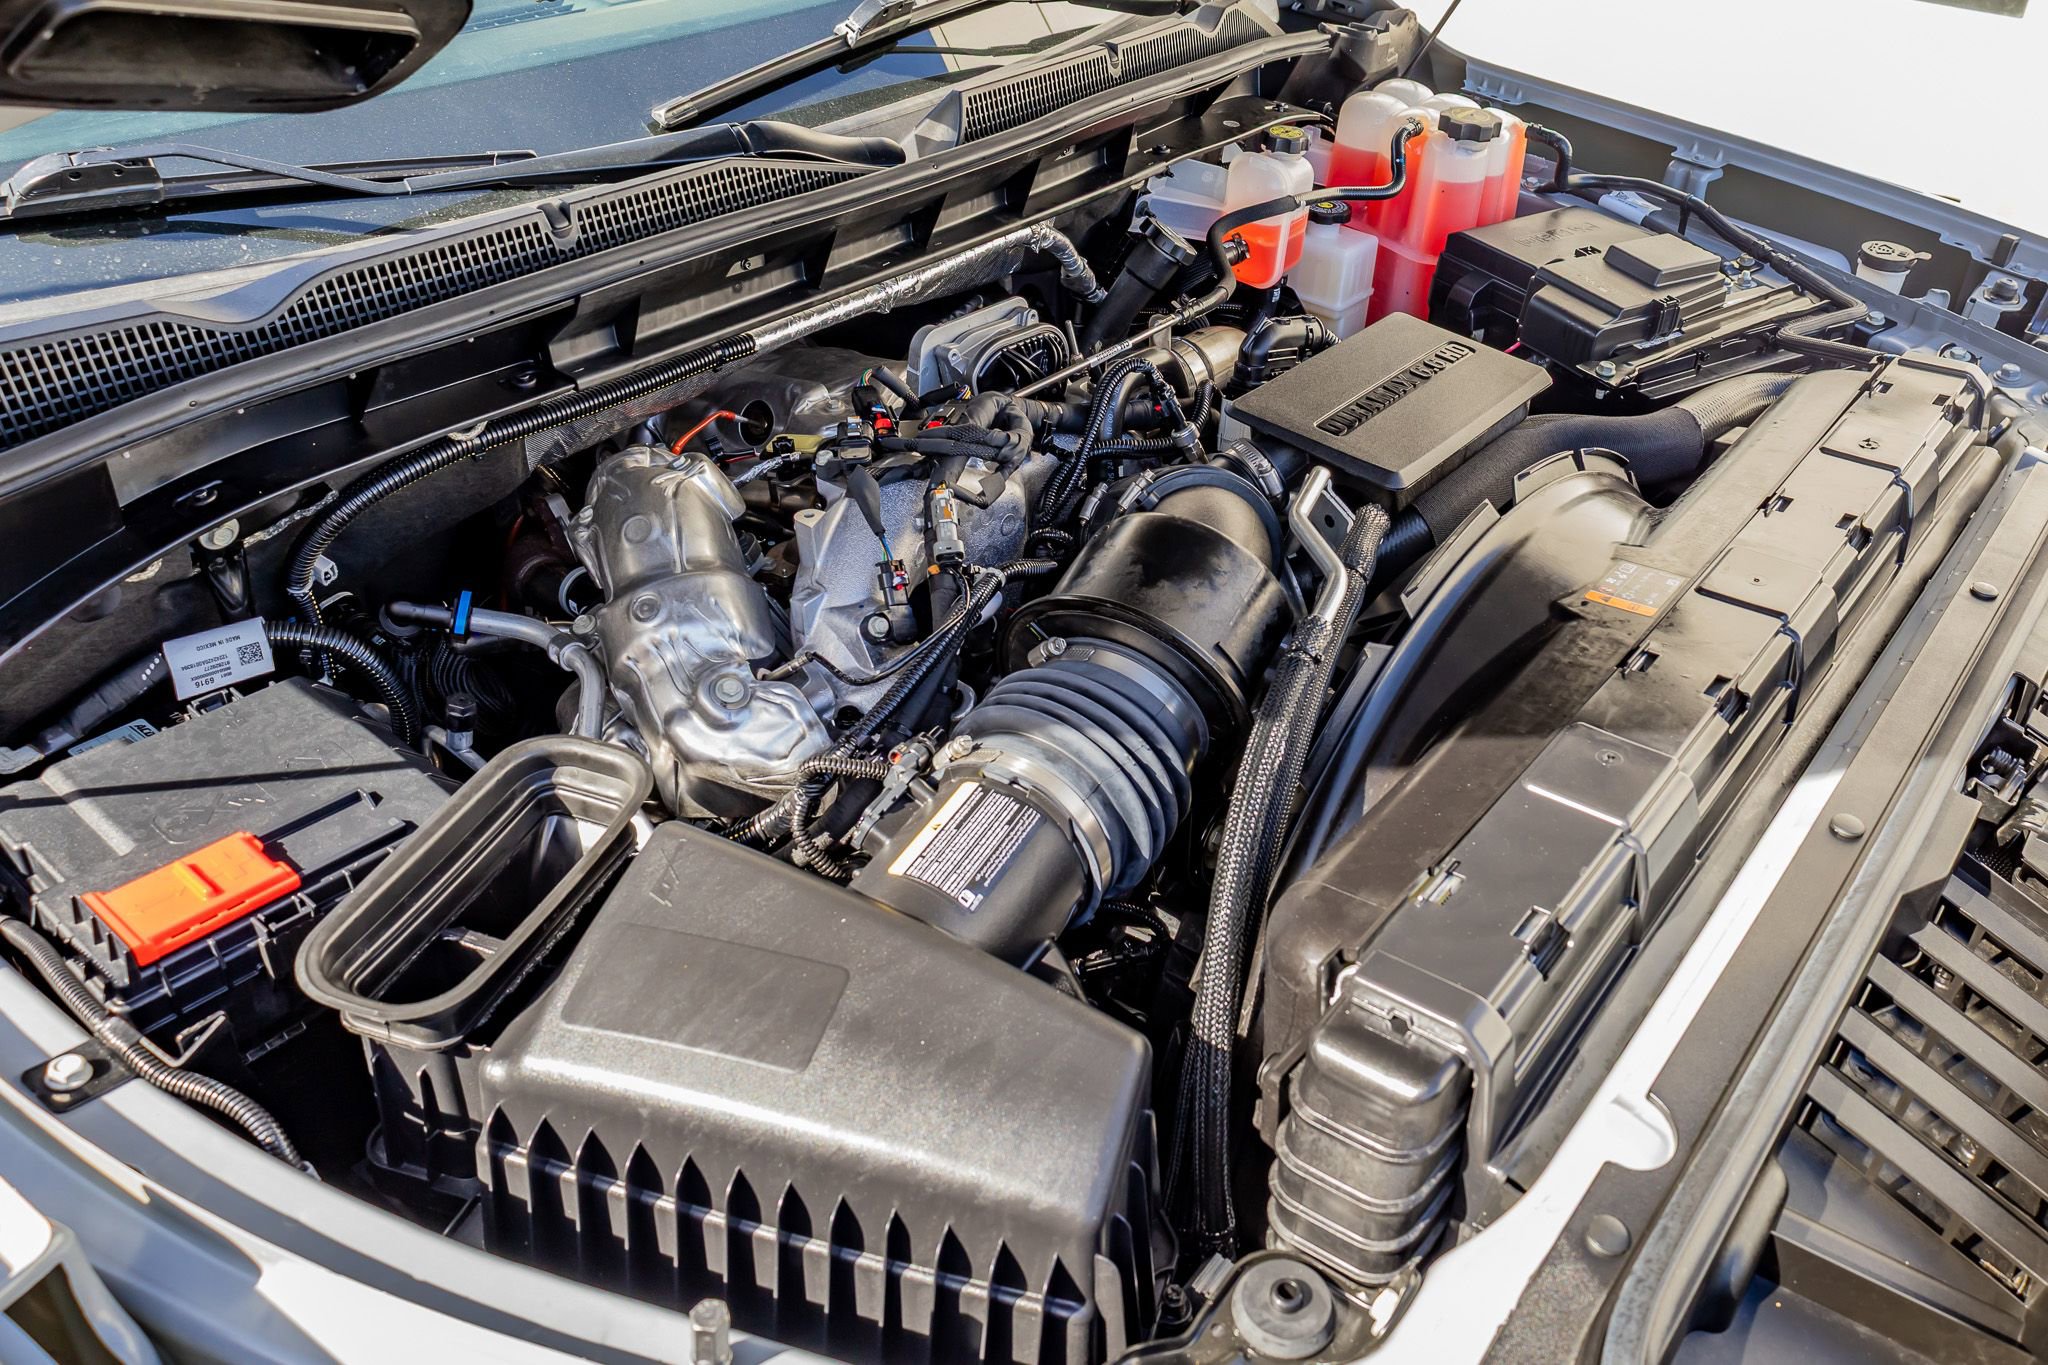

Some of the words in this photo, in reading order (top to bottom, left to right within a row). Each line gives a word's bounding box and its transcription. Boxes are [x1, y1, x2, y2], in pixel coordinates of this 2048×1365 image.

[1319, 375, 1420, 437] DURAMAX
[1409, 356, 1447, 380] 6.6
[1434, 343, 1474, 365] HD
[225, 635, 241, 644] MADE
[196, 641, 217, 652] MEXICO
[195, 677, 215, 688] 6916
